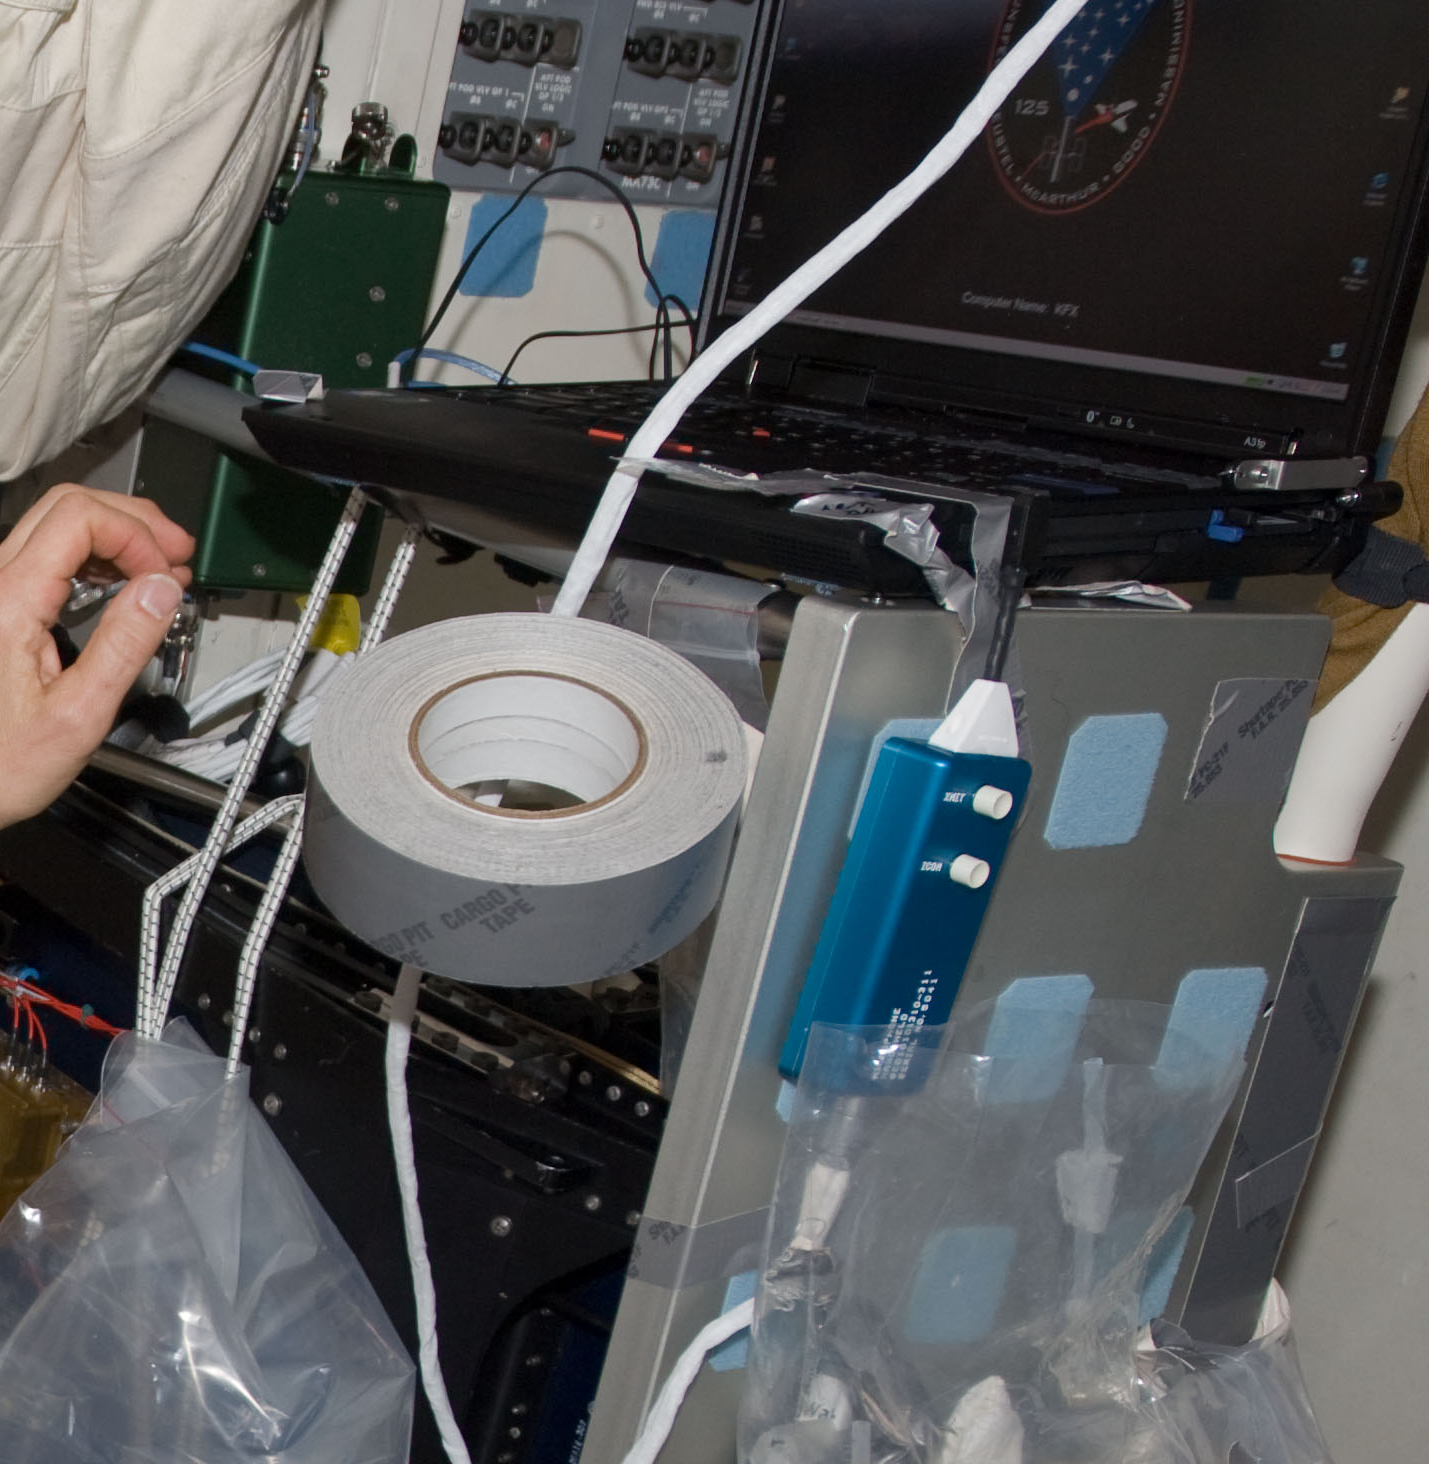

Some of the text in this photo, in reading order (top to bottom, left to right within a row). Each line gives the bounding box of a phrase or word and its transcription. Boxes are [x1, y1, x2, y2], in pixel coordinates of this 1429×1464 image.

[1014, 99, 1051, 116] 125
[441, 888, 508, 931] CARGO
[479, 898, 536, 934] TAPE
[401, 921, 436, 947] PIT
